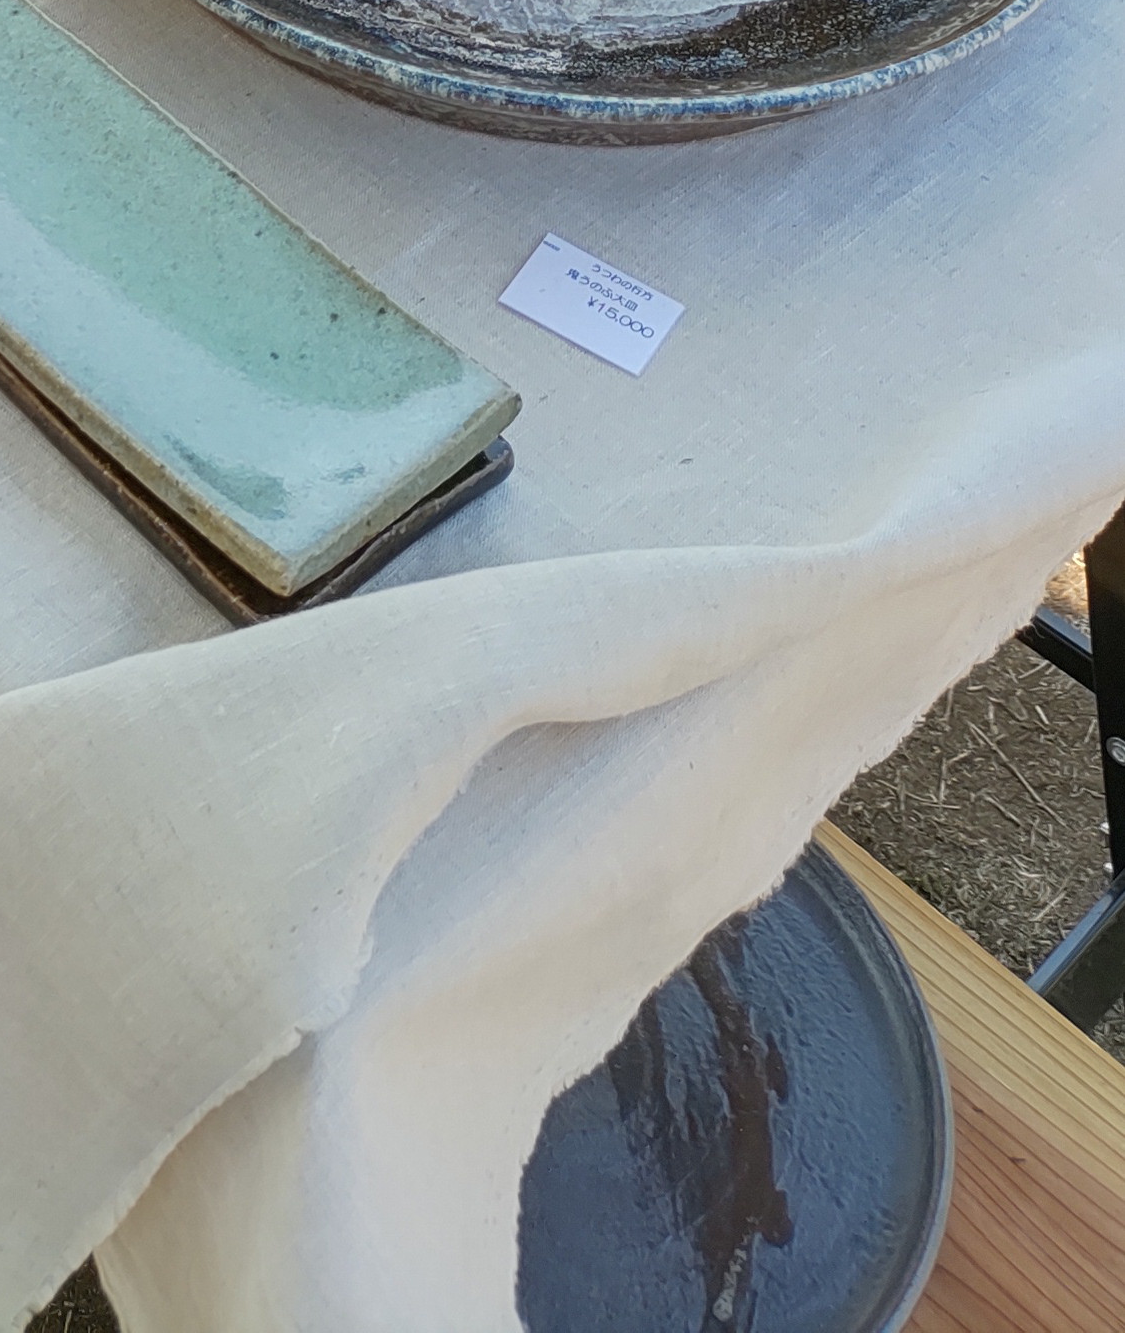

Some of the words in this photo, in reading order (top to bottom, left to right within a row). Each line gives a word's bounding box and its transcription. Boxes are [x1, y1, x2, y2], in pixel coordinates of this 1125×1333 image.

[565, 268, 638, 312] 鬼うのふ大皿
[591, 263, 655, 302] うつわの行方
[587, 296, 655, 339] ¥15,000
